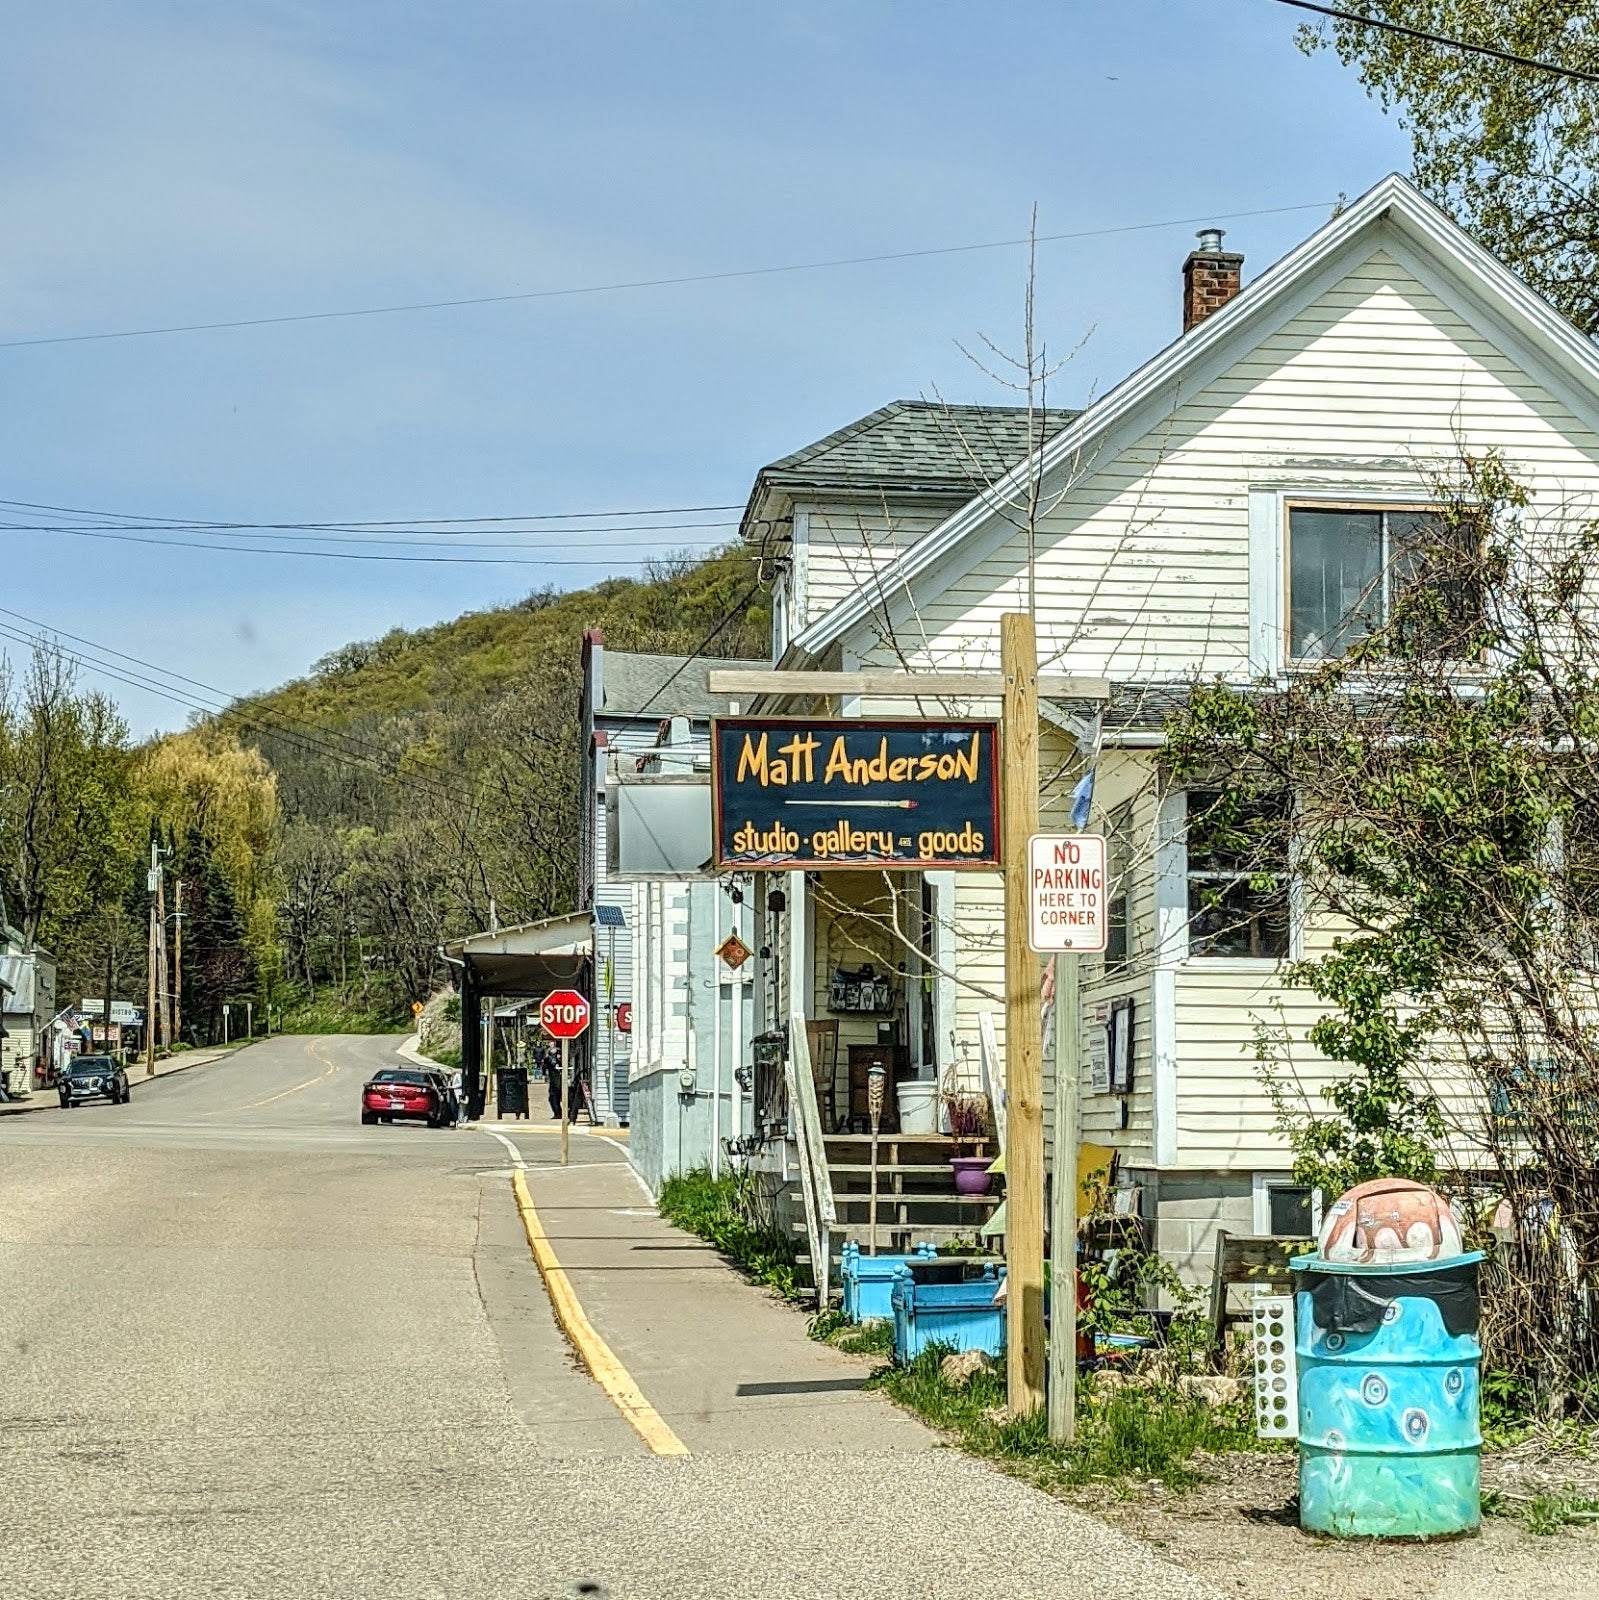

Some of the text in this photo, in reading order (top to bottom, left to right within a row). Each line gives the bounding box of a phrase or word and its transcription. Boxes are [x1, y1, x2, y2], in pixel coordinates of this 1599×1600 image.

[737, 731, 822, 787] Matt
[733, 820, 984, 859] studio gallery goods
[1054, 844, 1080, 864] NO
[1035, 868, 1101, 889] PARKING
[1040, 893, 1096, 907] HERE TO
[1041, 911, 1095, 925] CORNER
[543, 1004, 586, 1024] STOP
